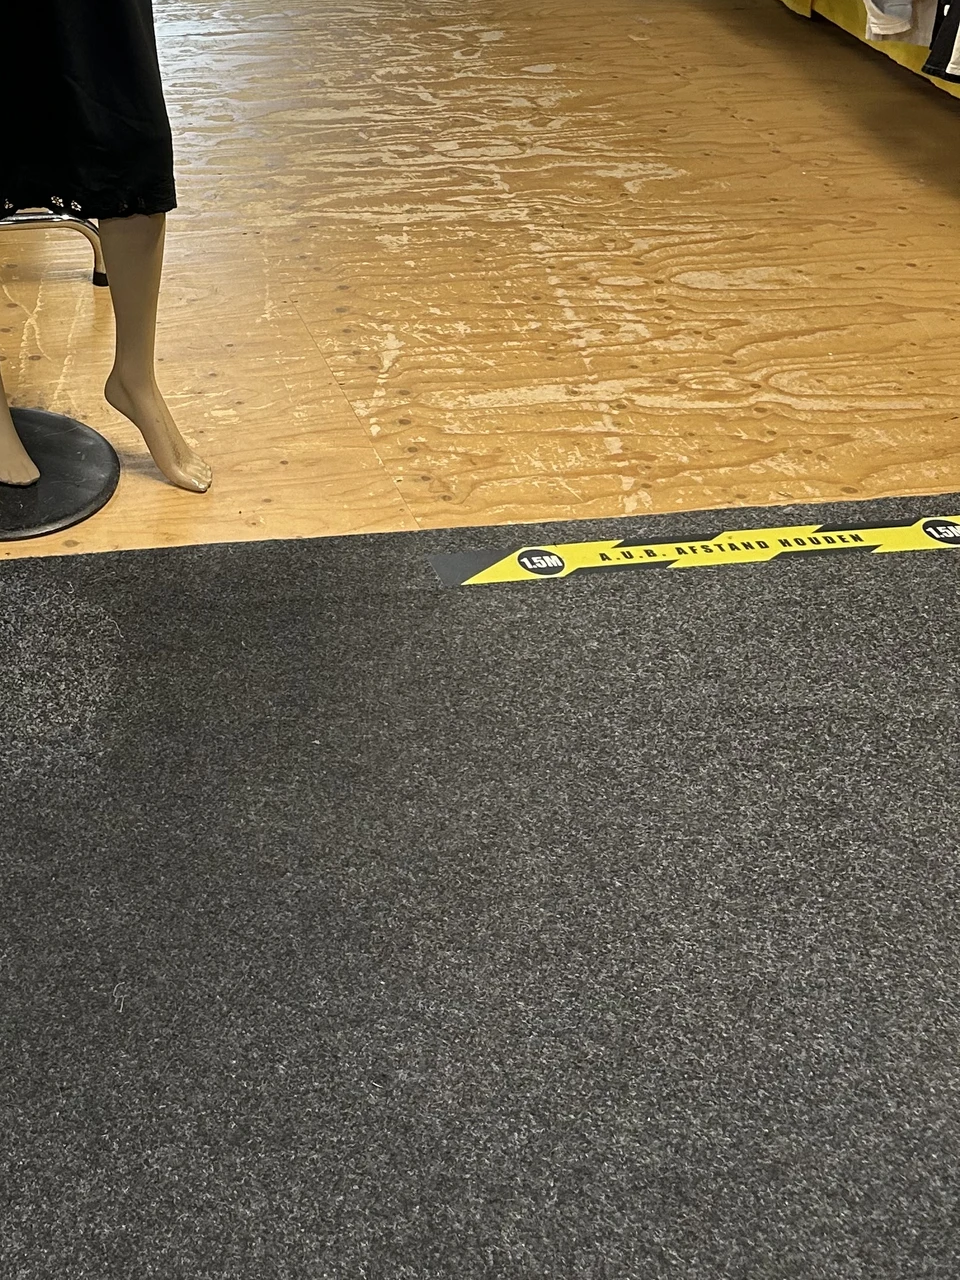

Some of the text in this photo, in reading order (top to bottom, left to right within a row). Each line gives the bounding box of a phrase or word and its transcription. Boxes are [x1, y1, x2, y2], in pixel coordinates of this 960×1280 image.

[520, 555, 563, 569] 1.5M
[599, 548, 666, 562] A.U.B.
[675, 540, 770, 556] AFSTAND
[778, 533, 864, 548] HOUDEN
